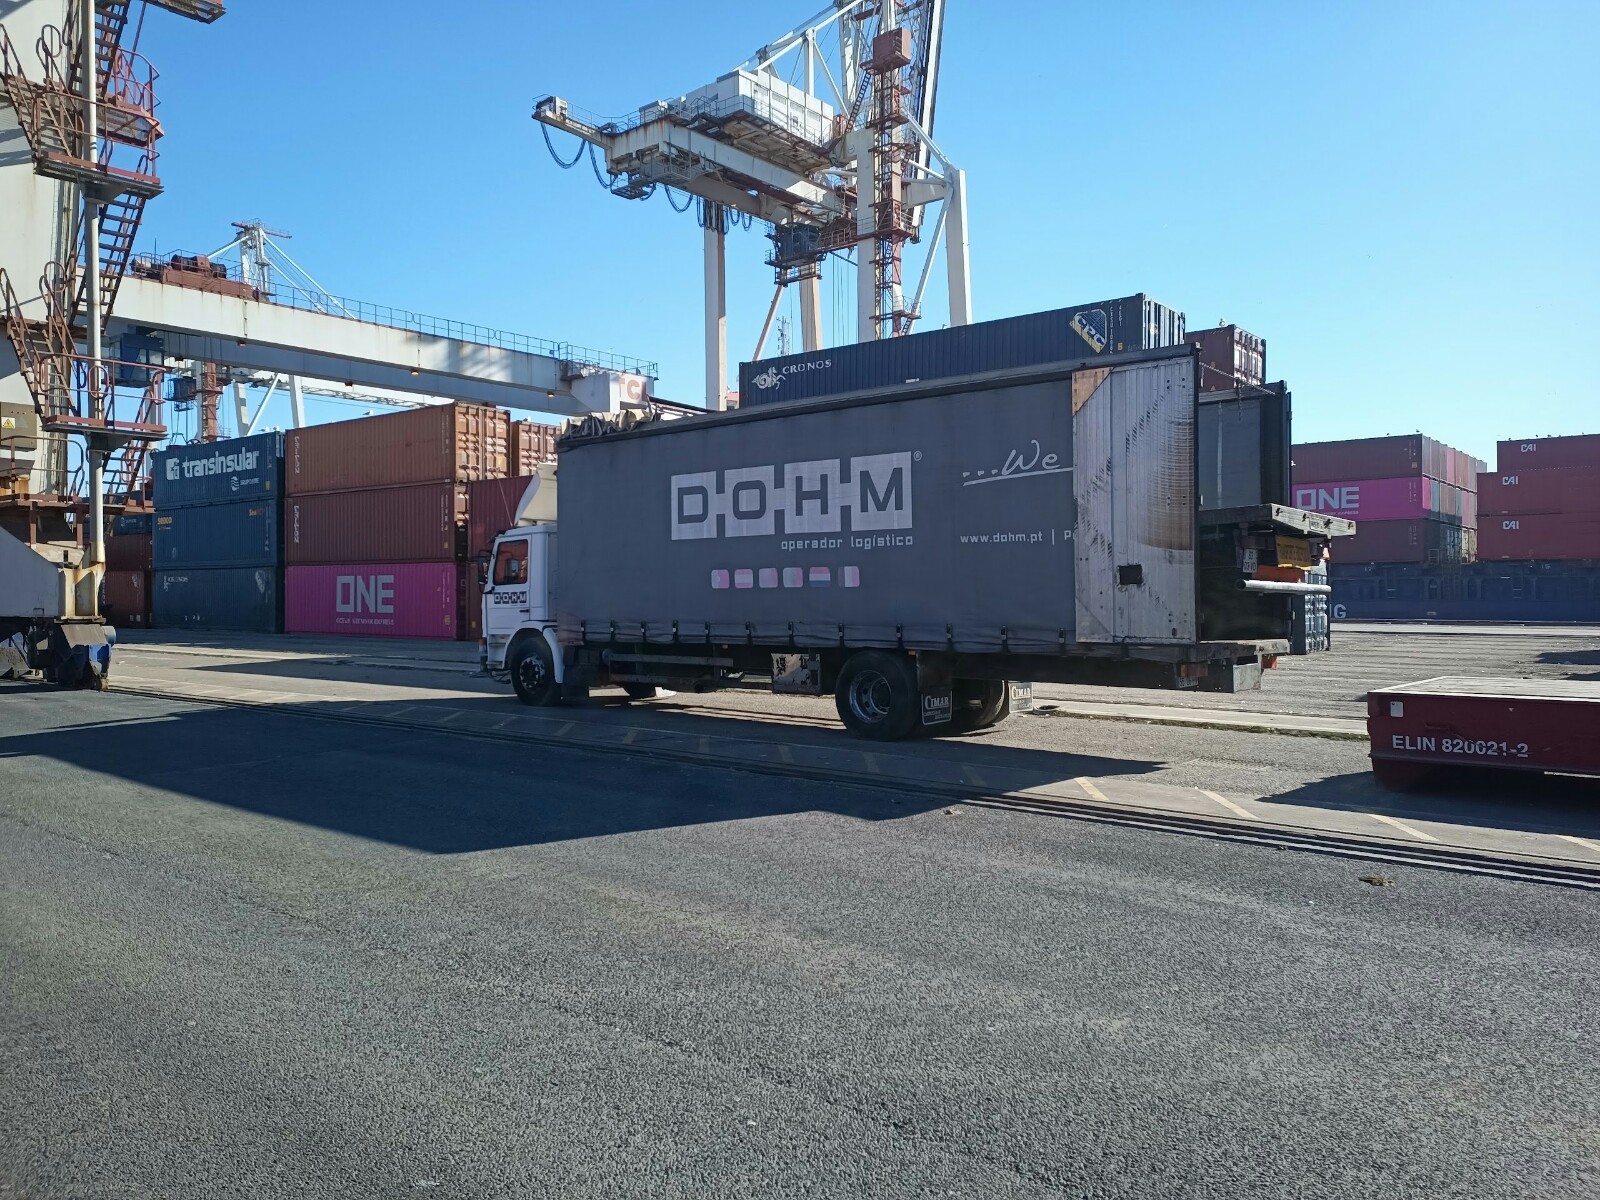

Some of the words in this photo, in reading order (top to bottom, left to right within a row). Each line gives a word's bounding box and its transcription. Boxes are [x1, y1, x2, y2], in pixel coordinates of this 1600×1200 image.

[782, 359, 832, 375] CRONOS
[1520, 443, 1537, 453] CAI
[182, 446, 260, 478] transinsular
[1502, 475, 1519, 486] CAI
[676, 463, 905, 527] DOHM
[1296, 486, 1360, 510] ONE
[1502, 520, 1520, 530] CAI
[781, 536, 843, 552] operador
[850, 533, 913, 550] logístico
[959, 531, 1043, 544] www.dohm.pt
[336, 574, 395, 614] ONE
[494, 592, 527, 604] DOHM
[1329, 603, 1347, 619] G
[1011, 685, 1032, 699] CIMAR
[924, 695, 949, 708] CIMAR
[1392, 734, 1436, 752] ELIN
[1441, 738, 1529, 758] 820021-2
